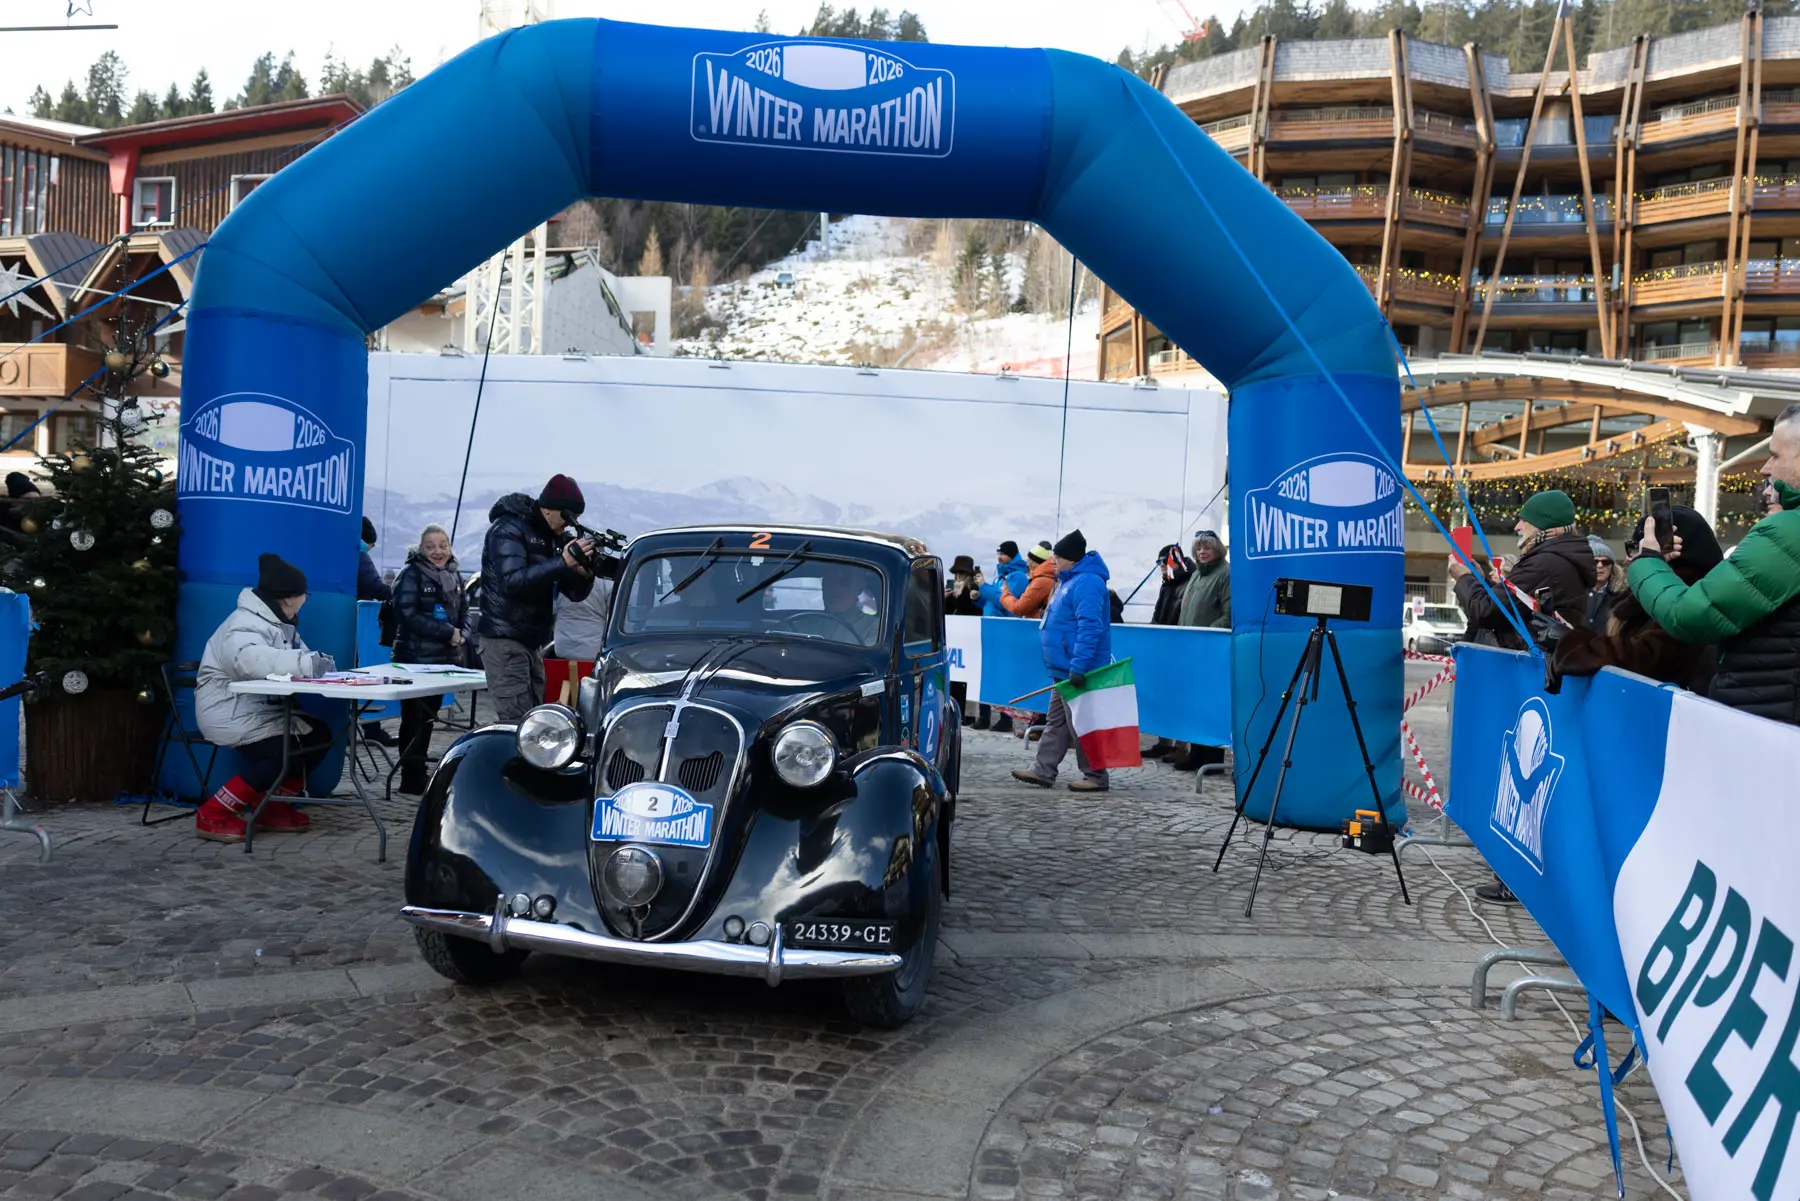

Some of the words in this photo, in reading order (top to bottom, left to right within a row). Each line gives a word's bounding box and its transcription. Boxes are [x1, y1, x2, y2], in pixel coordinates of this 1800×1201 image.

[745, 47, 781, 78] 2026
[868, 54, 904, 86] 2026
[706, 59, 803, 141] WINTER
[813, 76, 943, 149] MARATHON
[194, 407, 220, 441] 2026
[296, 415, 326, 449] 2026
[178, 432, 235, 493] WINTER
[243, 447, 349, 507] MARATHON
[1278, 470, 1308, 501] 2026
[1376, 467, 1396, 500] 2026
[749, 532, 772, 549] 2
[1252, 496, 1328, 552] WINTER
[926, 710, 935, 754] 2
[601, 801, 641, 836] WINTER
[645, 808, 708, 842] MARATHON
[648, 796, 659, 812] 2
[672, 794, 694, 816] 2026
